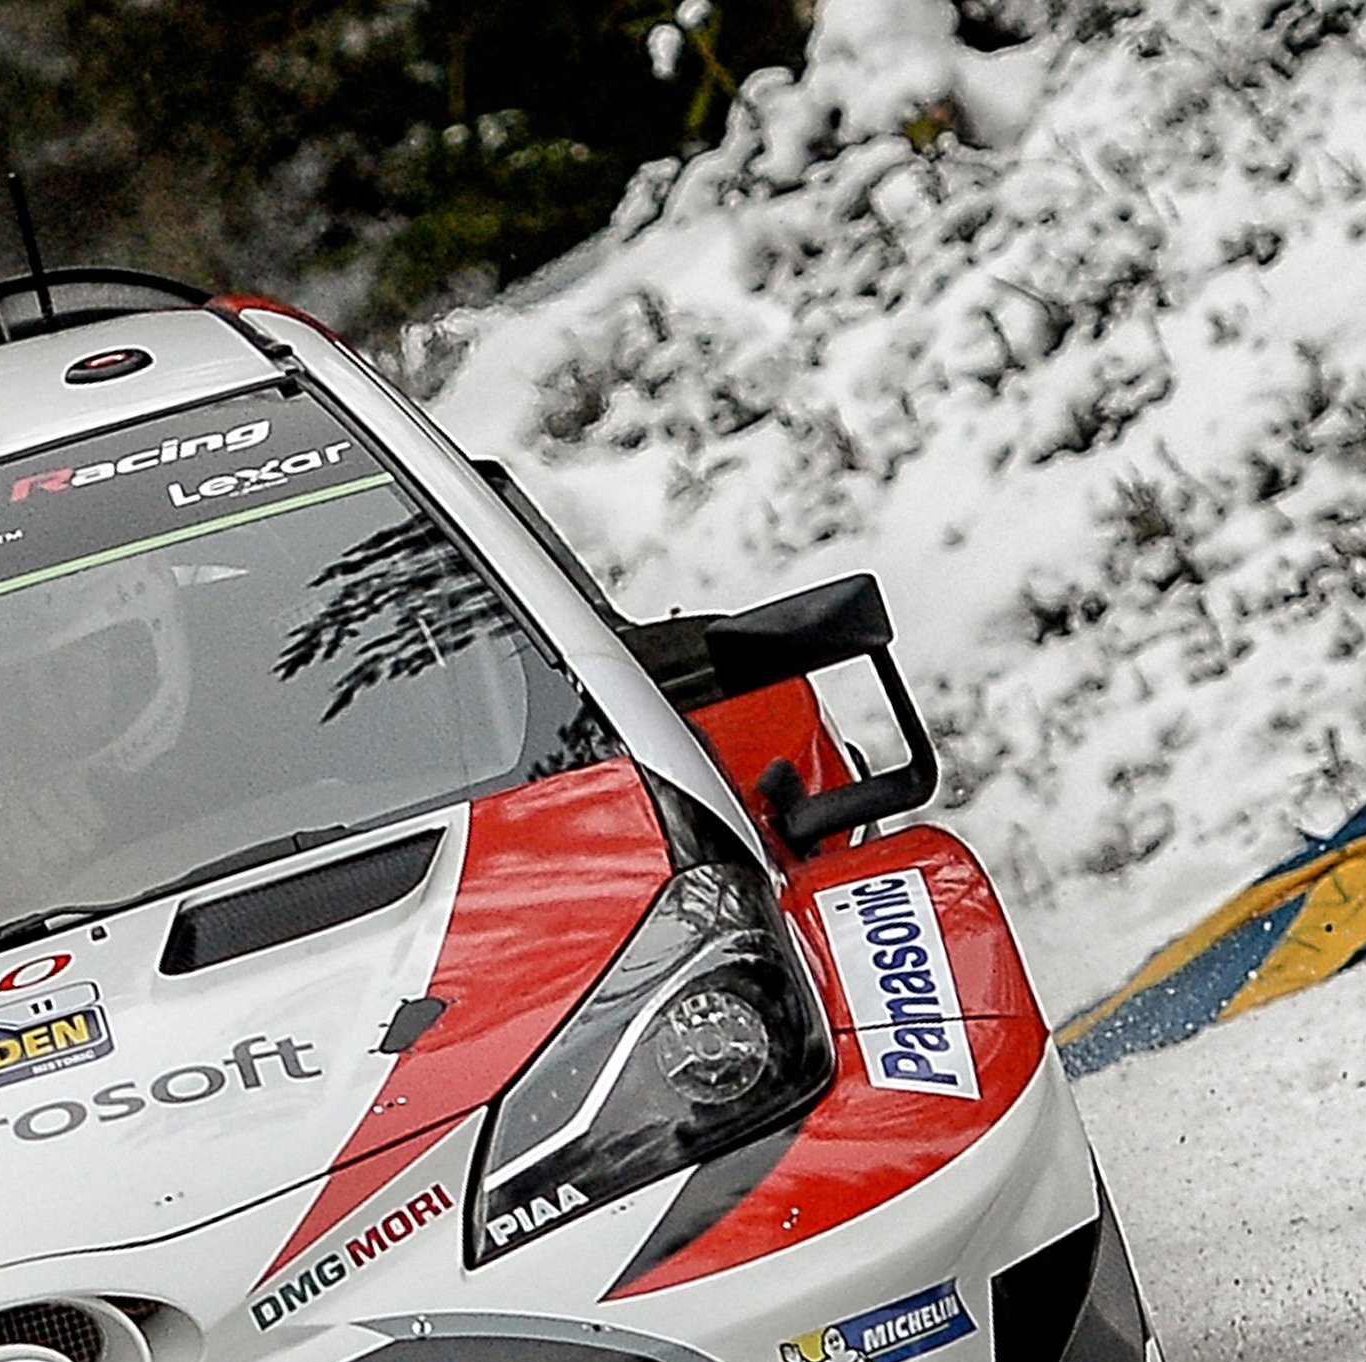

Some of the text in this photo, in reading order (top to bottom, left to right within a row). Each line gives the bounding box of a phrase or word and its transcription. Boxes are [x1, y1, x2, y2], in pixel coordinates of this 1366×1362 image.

[11, 419, 271, 502] Racing
[167, 441, 351, 507] Lexar
[834, 875, 960, 1086] Panasonic
[485, 1183, 590, 1246] PIAA
[249, 1184, 456, 1332] DMG MORI
[863, 1295, 960, 1352] MICHELIN
